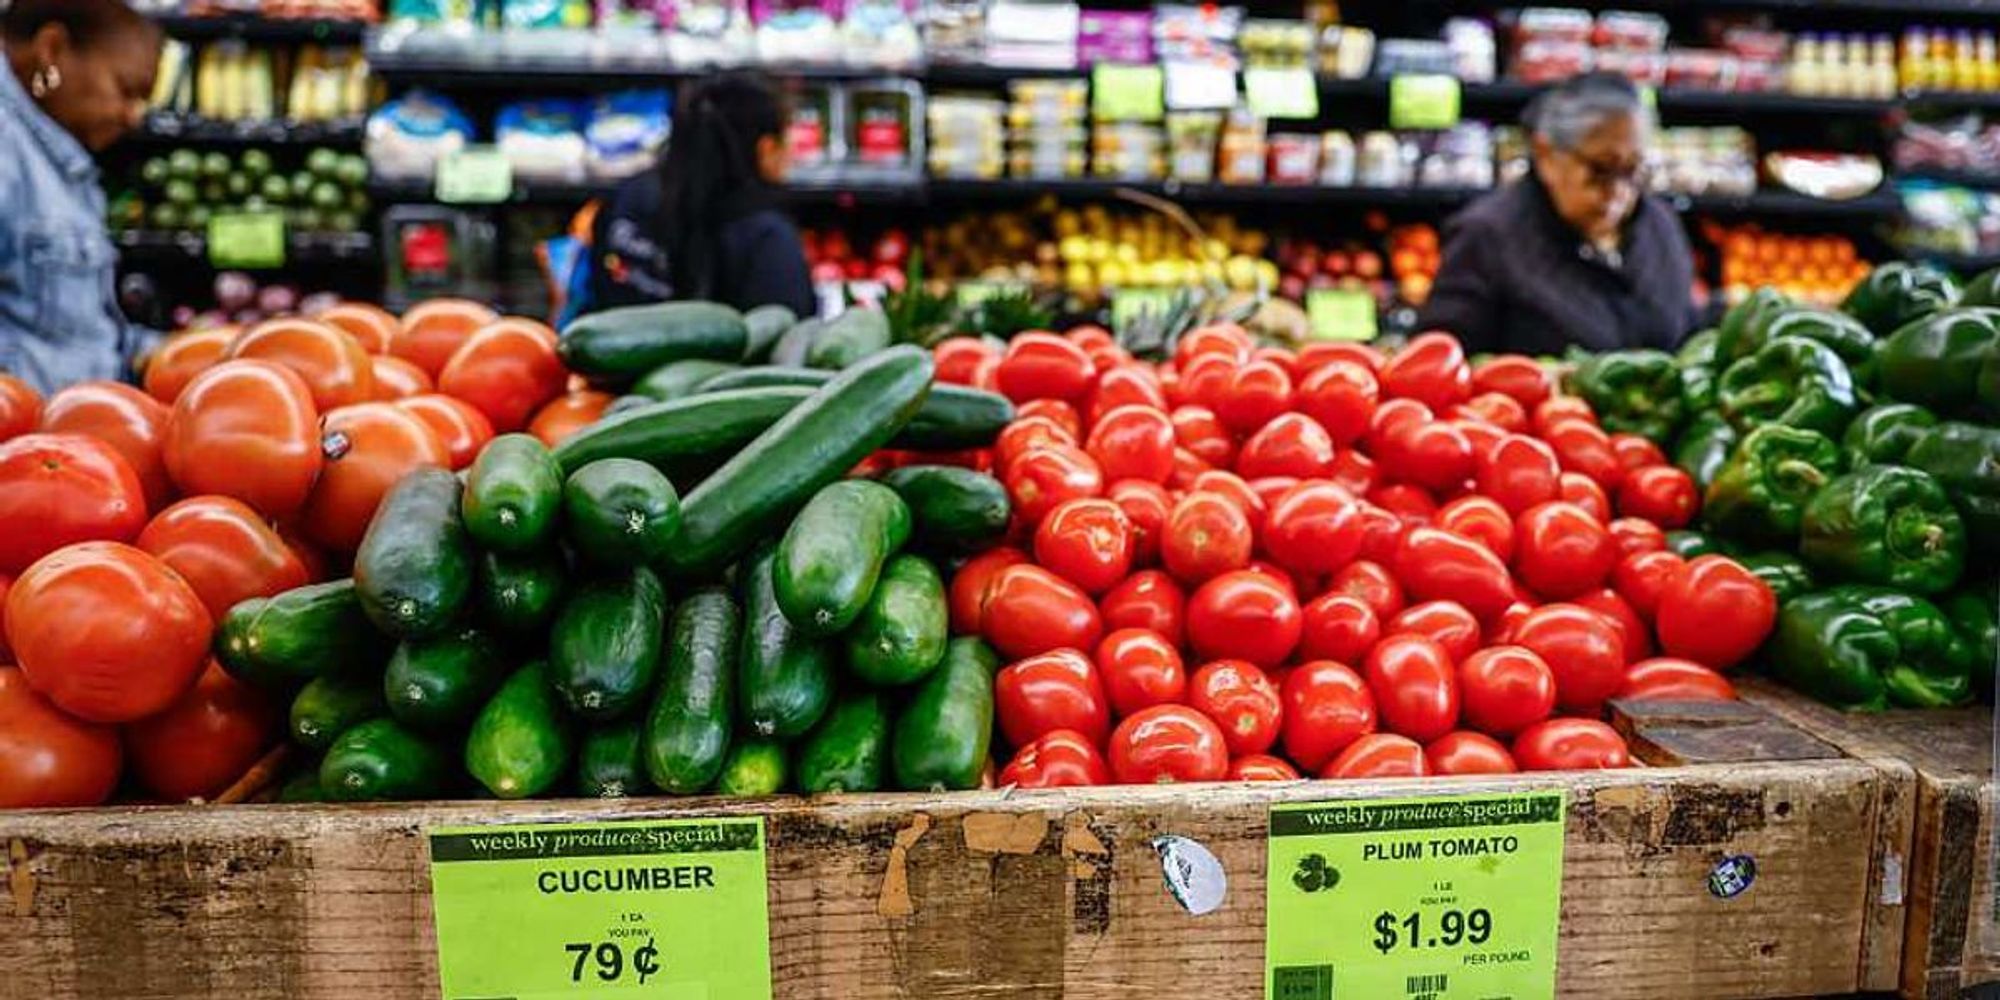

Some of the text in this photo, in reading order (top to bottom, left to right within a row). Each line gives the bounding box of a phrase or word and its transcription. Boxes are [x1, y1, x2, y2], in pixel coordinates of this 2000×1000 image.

[1306, 799, 1531, 827] weekly produce special
[470, 824, 723, 854] weekly produce special
[1363, 836, 1518, 861] PLUM TOMATO
[538, 866, 715, 894] CUCUMBER
[1373, 908, 1491, 955] $1.99
[1463, 950, 1531, 965] PER POUND
